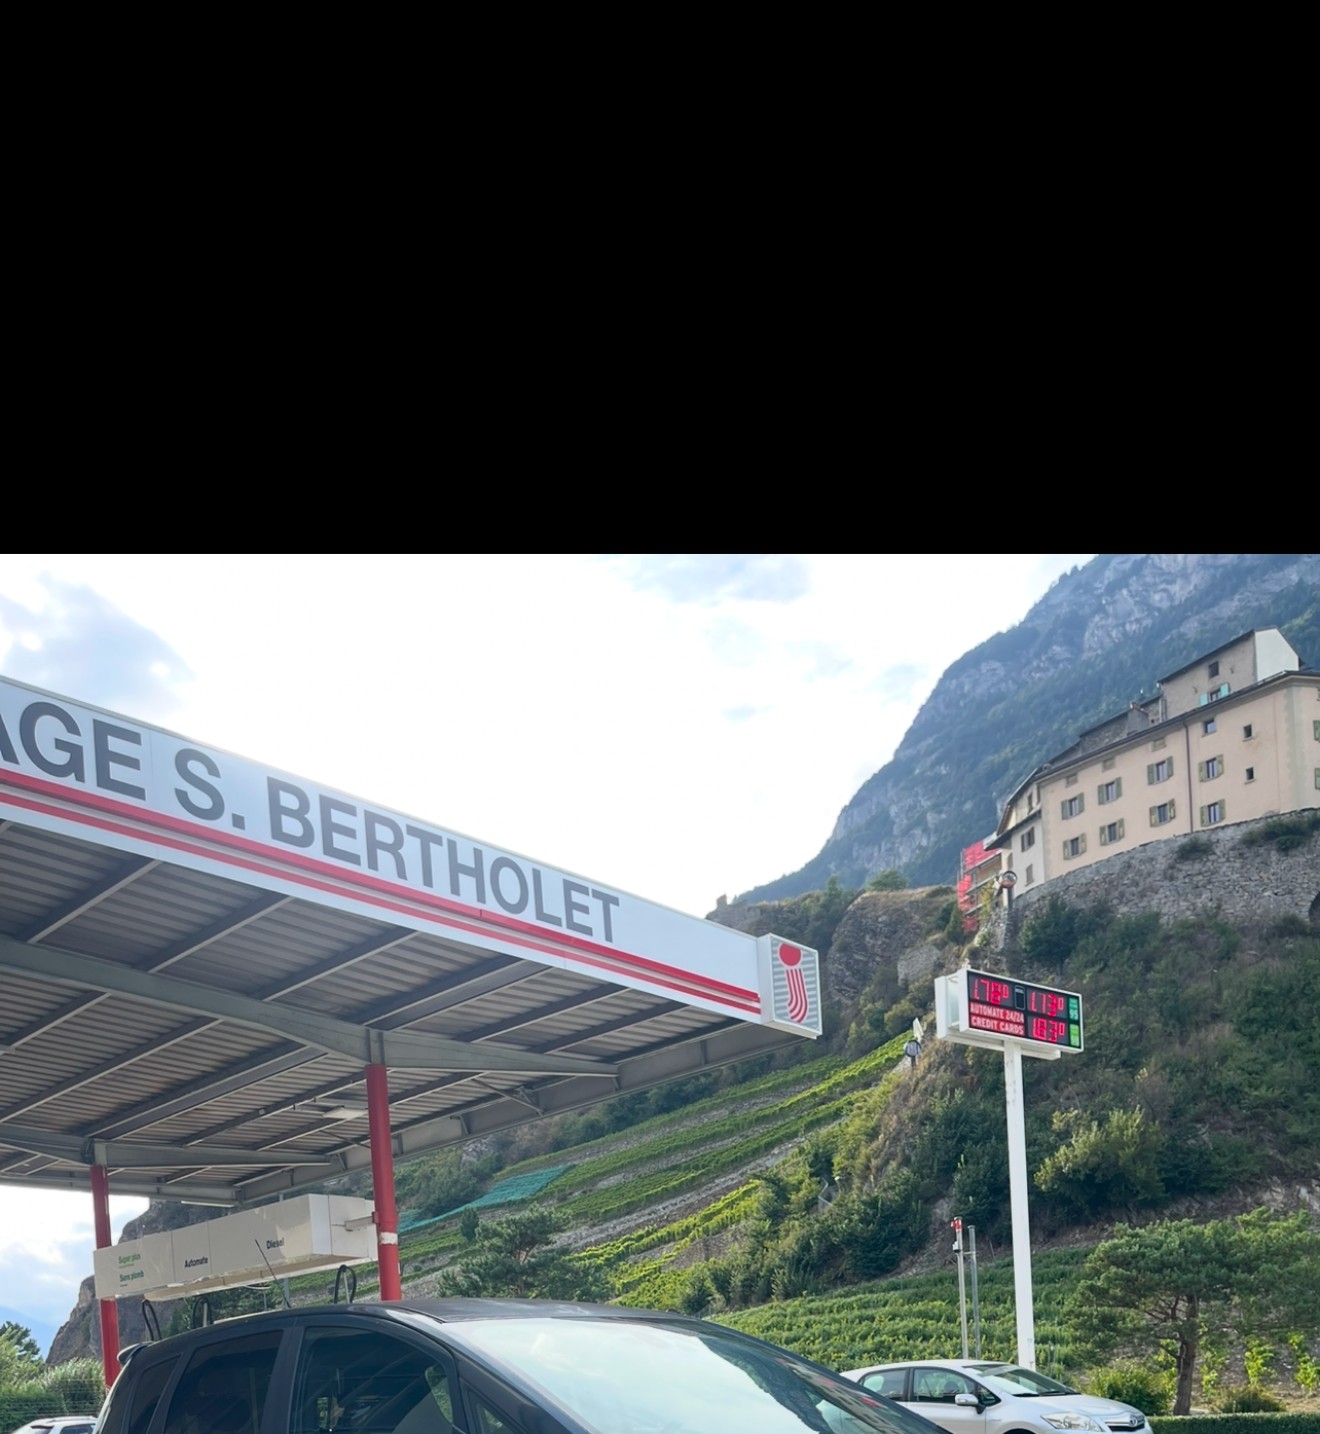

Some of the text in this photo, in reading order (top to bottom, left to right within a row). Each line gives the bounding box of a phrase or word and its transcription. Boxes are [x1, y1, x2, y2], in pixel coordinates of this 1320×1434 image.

[174, 747, 246, 831] S.
[266, 775, 620, 943] BERTHOLET
[970, 1001, 1025, 1023] AUTOMATE 24/24
[970, 1015, 1025, 1036] CREDIT CARDS
[266, 1237, 285, 1249] Diesel
[184, 1255, 209, 1268] Automate
